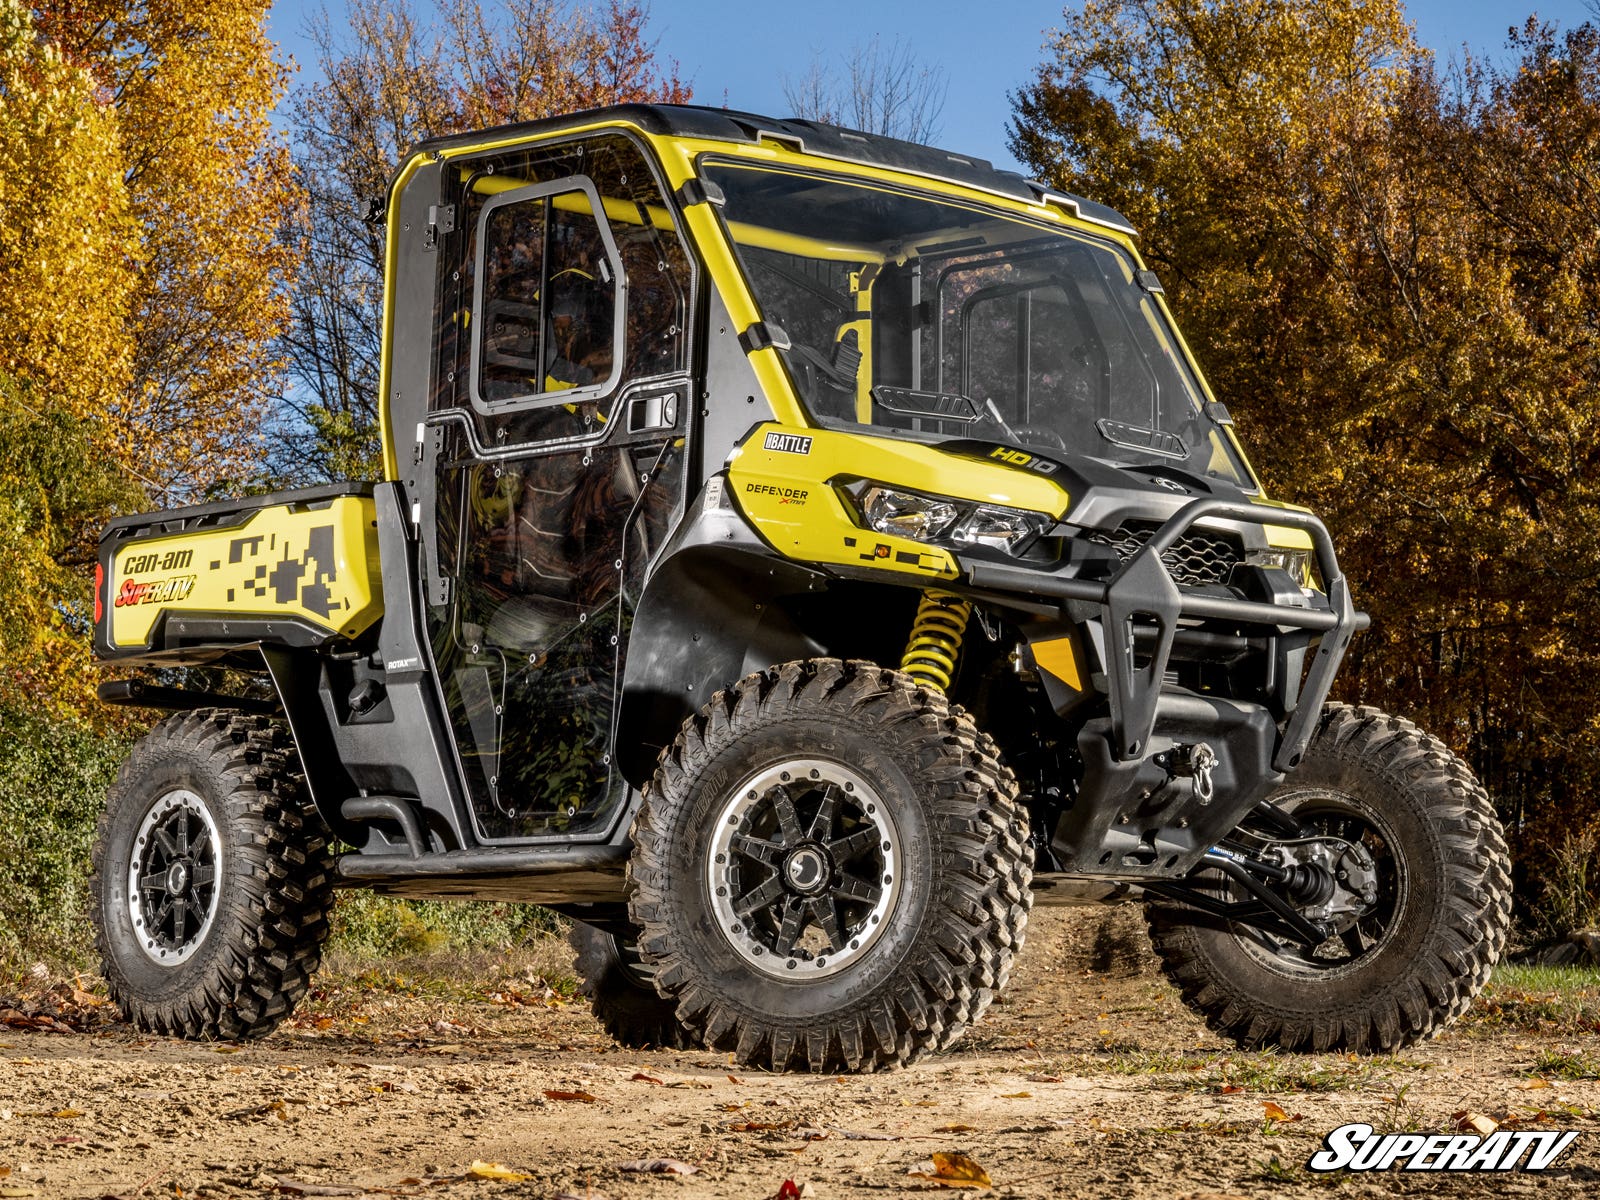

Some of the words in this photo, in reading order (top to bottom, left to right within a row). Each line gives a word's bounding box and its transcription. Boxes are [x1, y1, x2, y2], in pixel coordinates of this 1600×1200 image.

[770, 435, 810, 453] BATTLE
[990, 447, 1057, 474] HD10
[746, 483, 809, 500] DEFENDER
[123, 549, 193, 575] can-am
[114, 574, 196, 608] SUPERATV
[388, 659, 408, 669] ROTAX
